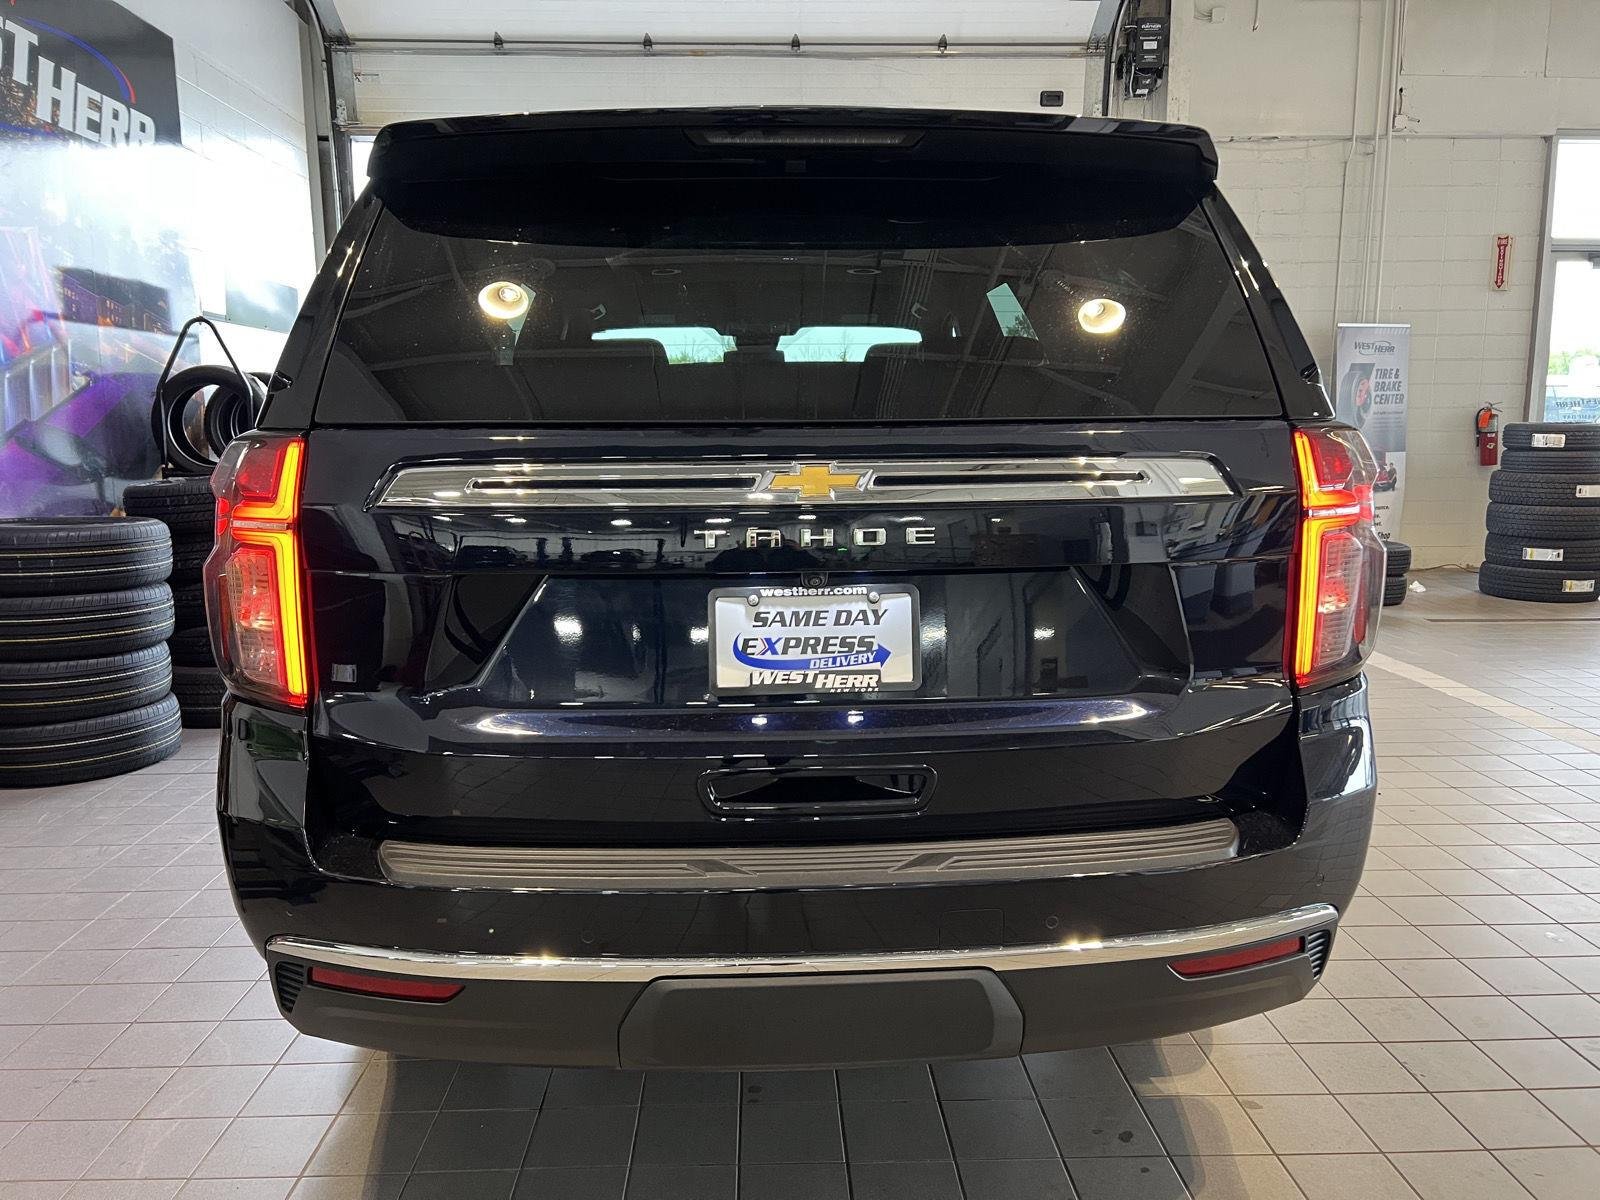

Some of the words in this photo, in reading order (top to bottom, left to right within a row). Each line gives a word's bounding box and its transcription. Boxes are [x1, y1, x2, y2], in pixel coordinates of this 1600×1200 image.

[36, 55, 156, 149] HERR
[1354, 341, 1376, 350] WEST
[1374, 345, 1396, 353] HERR
[1375, 368, 1393, 379] TIRE
[1395, 368, 1400, 379] &
[1374, 380, 1403, 393] BRAKE
[1373, 393, 1405, 405] CENTER
[693, 527, 937, 549] TAHOE
[759, 586, 868, 598] westherr.com
[752, 610, 830, 628] SAME
[833, 609, 889, 627] DAY
[741, 635, 876, 656] EXPRESS
[808, 652, 878, 670] DELIVERY
[751, 670, 820, 686] WEST
[814, 673, 880, 689] HERR
